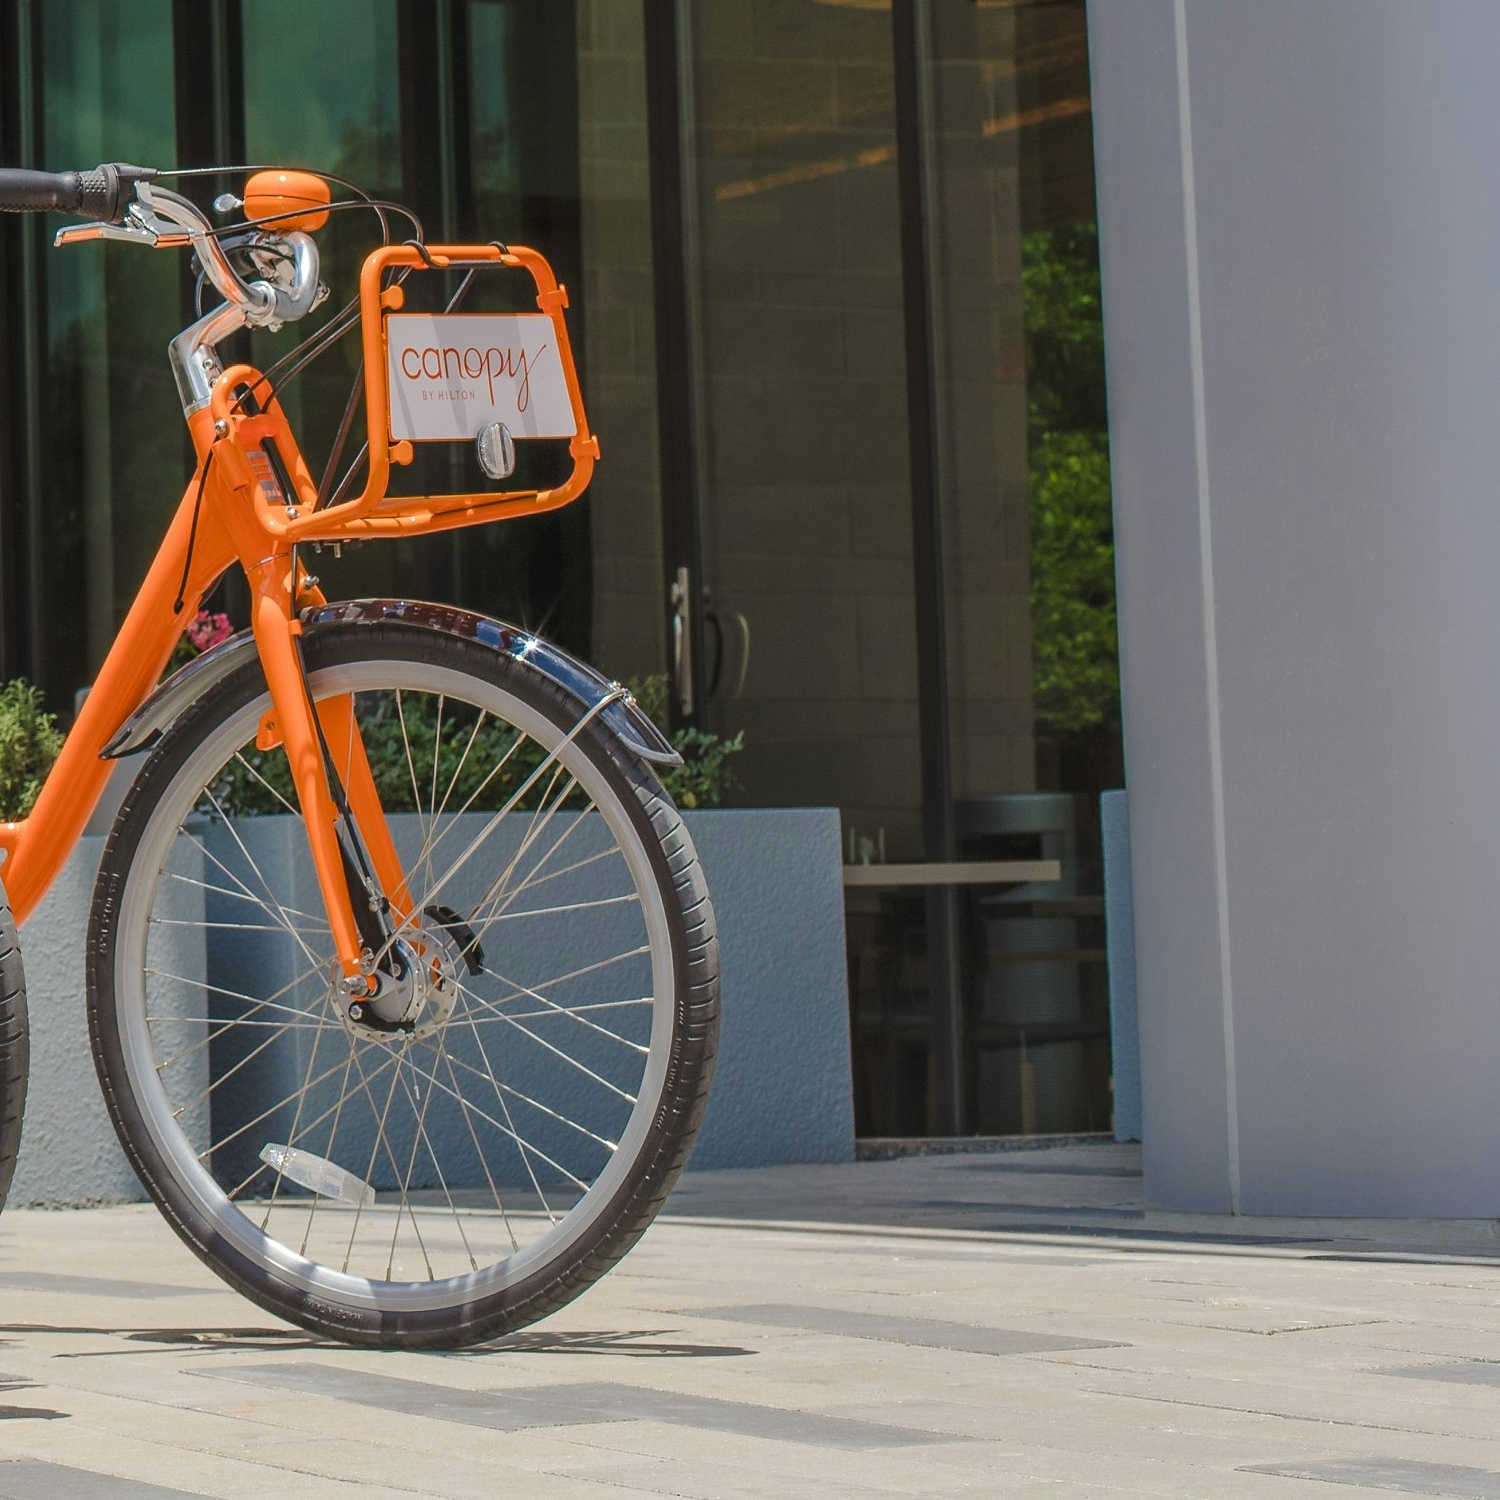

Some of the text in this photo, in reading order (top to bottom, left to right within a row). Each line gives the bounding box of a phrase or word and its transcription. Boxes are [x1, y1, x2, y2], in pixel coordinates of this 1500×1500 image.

[401, 344, 547, 413] canopy
[422, 389, 476, 401] BY HILTON
